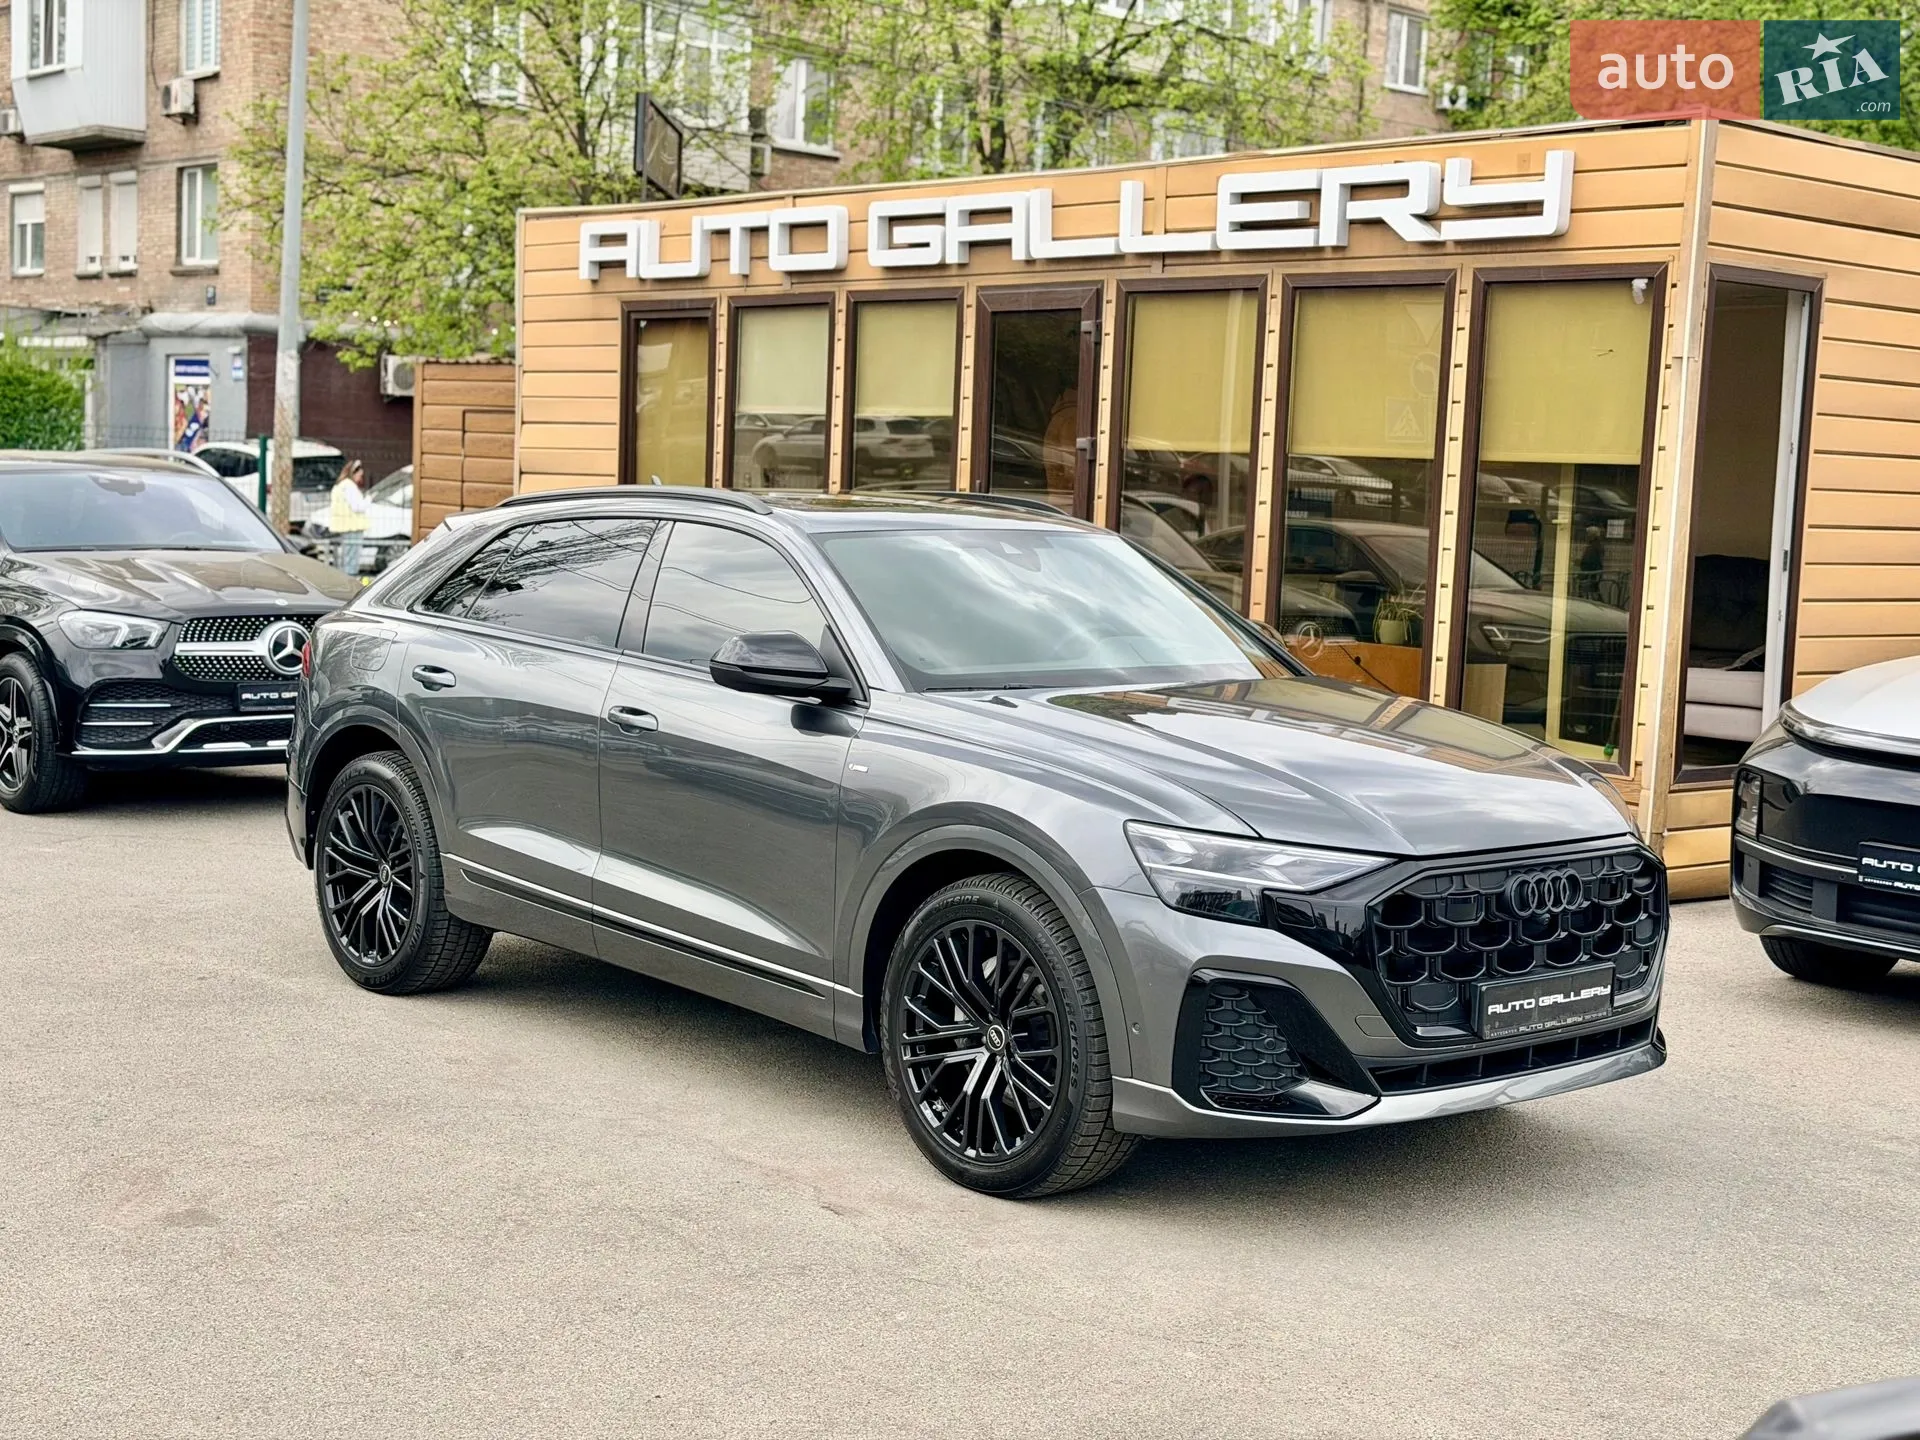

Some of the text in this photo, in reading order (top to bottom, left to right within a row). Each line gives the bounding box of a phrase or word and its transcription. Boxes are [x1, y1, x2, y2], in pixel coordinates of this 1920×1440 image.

[579, 149, 1576, 281] AUTO GALLERY
[241, 691, 279, 700] AUTO
[1861, 857, 1914, 872] AUTO
[1487, 984, 1612, 1015] AUTO GALLERY
[1518, 1023, 1543, 1033] AUTO
[1544, 1015, 1583, 1028] GALLERY
